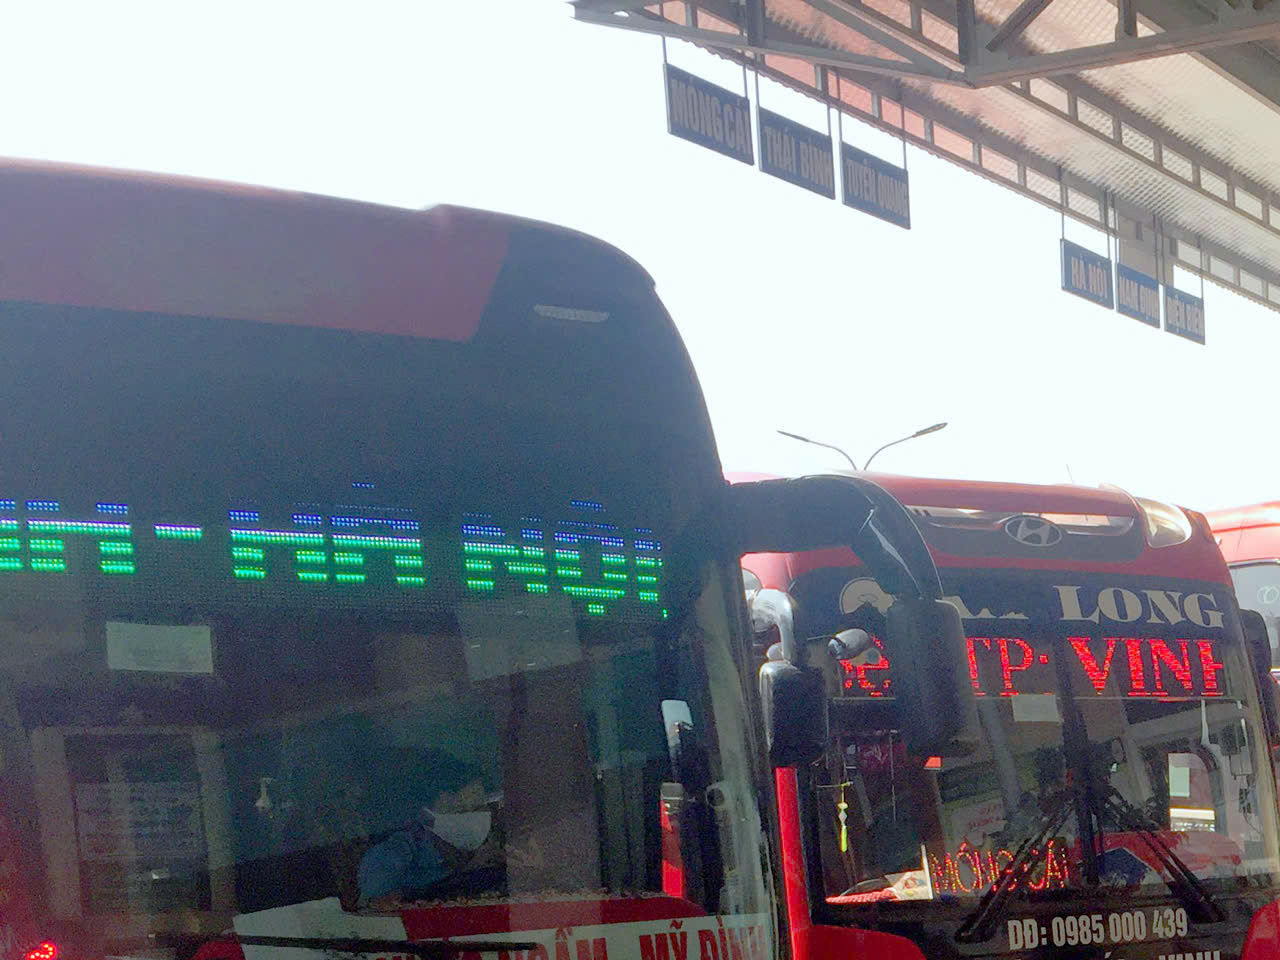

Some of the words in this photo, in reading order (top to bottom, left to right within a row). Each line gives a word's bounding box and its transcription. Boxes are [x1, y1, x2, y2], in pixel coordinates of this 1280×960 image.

[671, 76, 723, 143] MÓNG
[1071, 253, 1087, 290] HÀ
[1052, 585, 1225, 629] LONG
[1052, 914, 1104, 947] 0985
[1108, 910, 1147, 942] 000
[1152, 907, 1188, 938] 439
